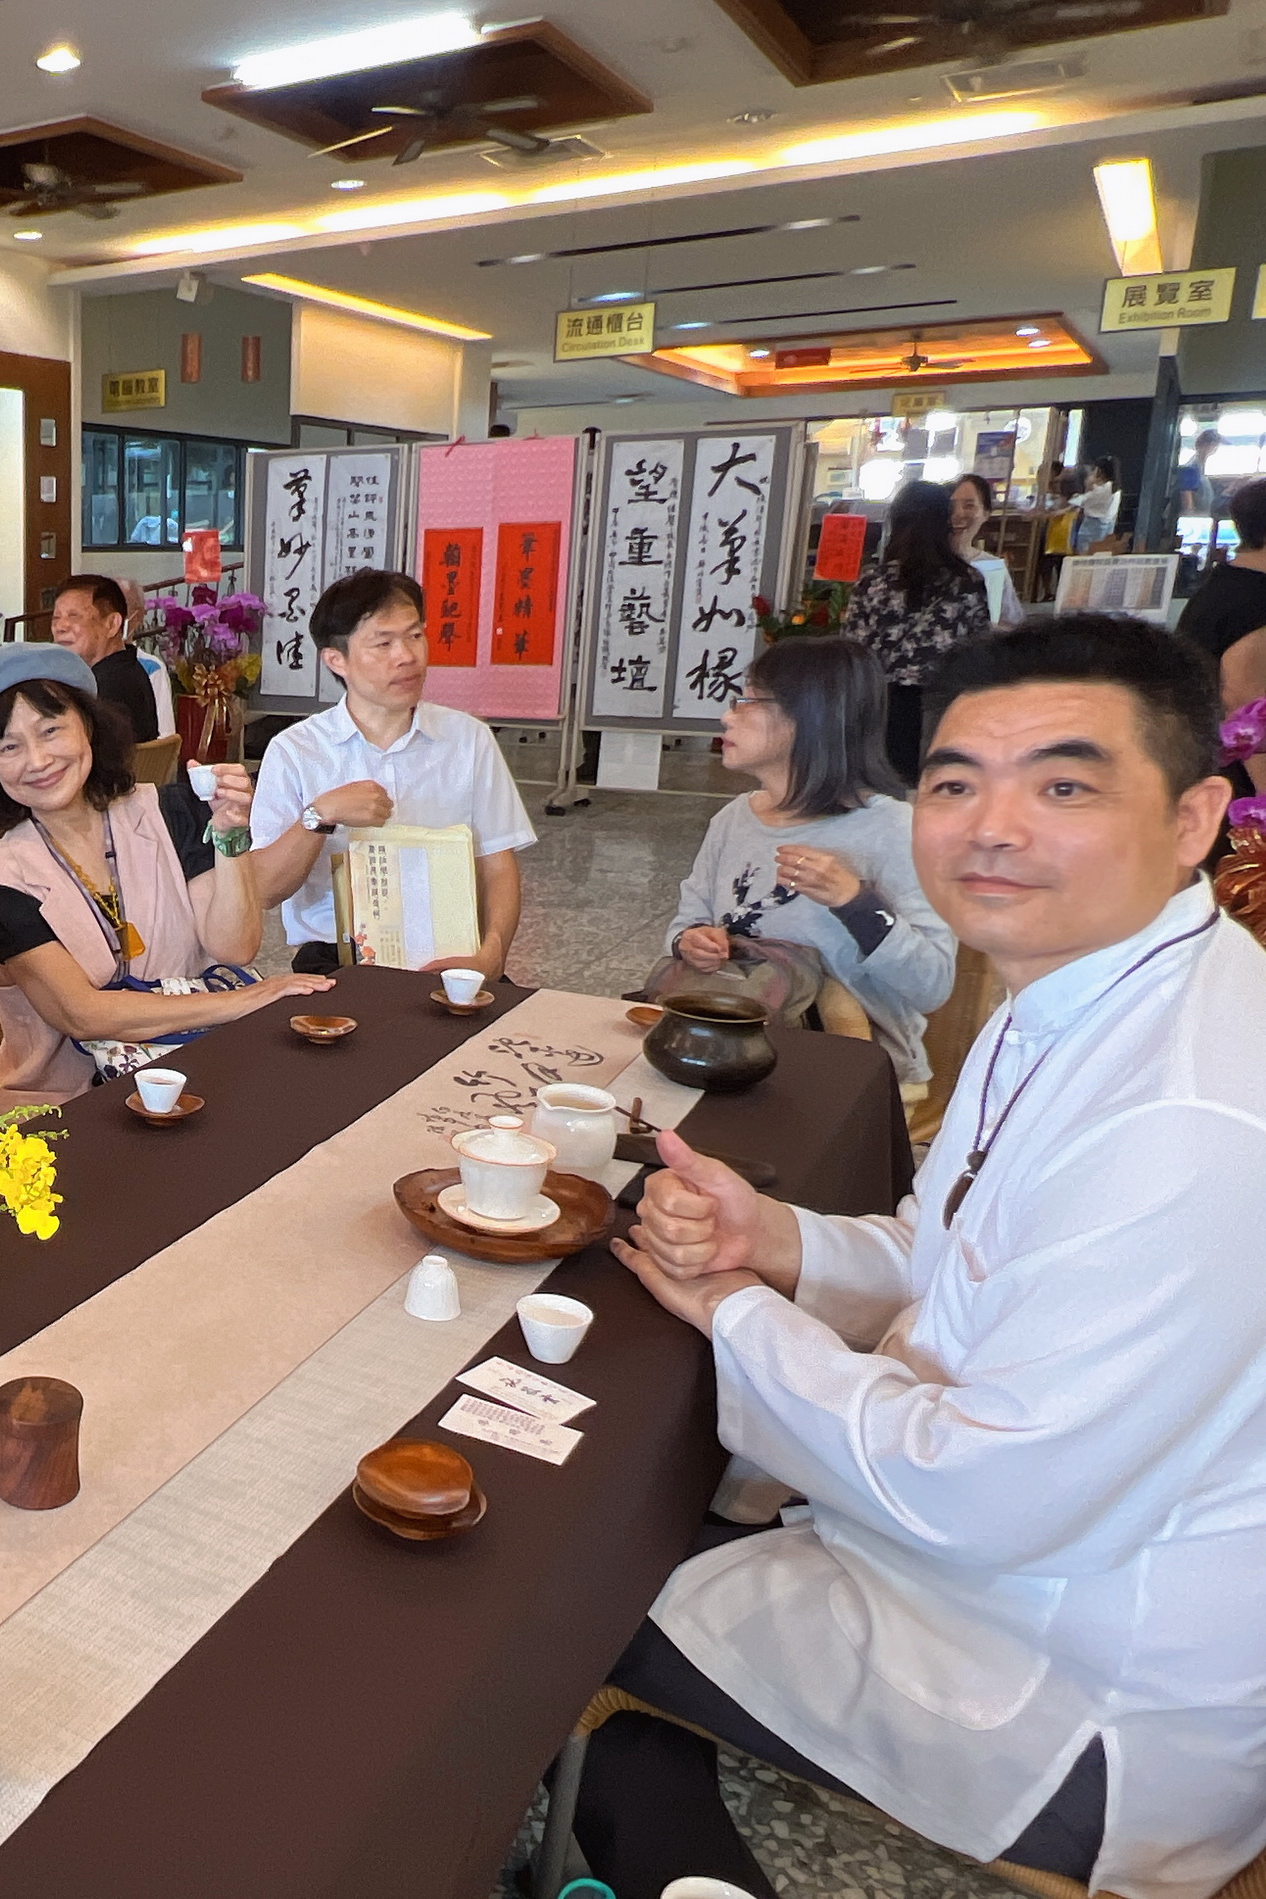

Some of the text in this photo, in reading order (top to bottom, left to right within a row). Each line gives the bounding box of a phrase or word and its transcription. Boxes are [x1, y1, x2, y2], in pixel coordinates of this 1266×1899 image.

[1121, 280, 1215, 308] 展覽室
[566, 311, 644, 338] 流通櫃台
[1118, 307, 1212, 324] Exhibition Room
[561, 336, 645, 353] Circulation Desk
[611, 459, 668, 691] 望重藝壇
[686, 442, 762, 702] 大筆如椽
